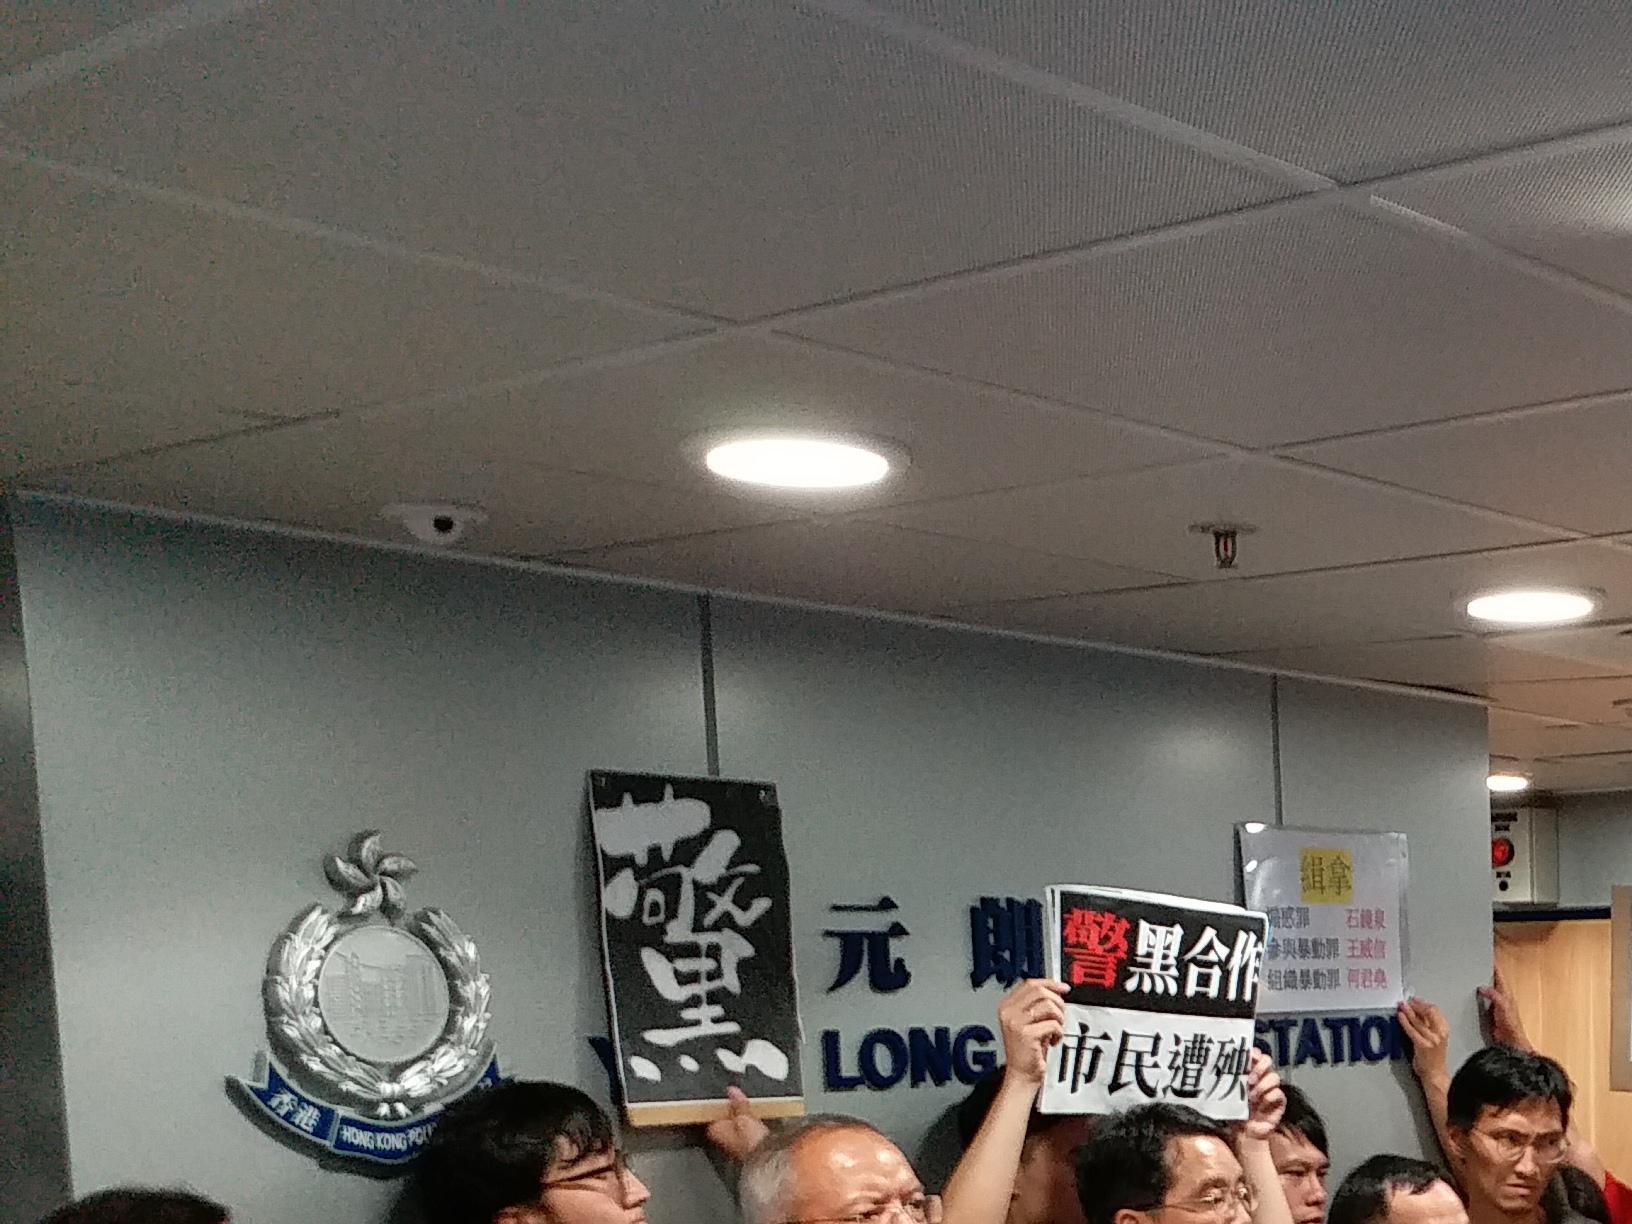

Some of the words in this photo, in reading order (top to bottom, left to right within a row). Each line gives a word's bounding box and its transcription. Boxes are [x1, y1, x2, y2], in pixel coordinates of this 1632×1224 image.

[1062, 906, 1262, 1002] 警黑合作
[821, 1025, 998, 1092] LONG
[1056, 1021, 1254, 1102] 市民遭殃
[342, 1124, 375, 1149] HONG
[376, 1132, 408, 1152] KONG
